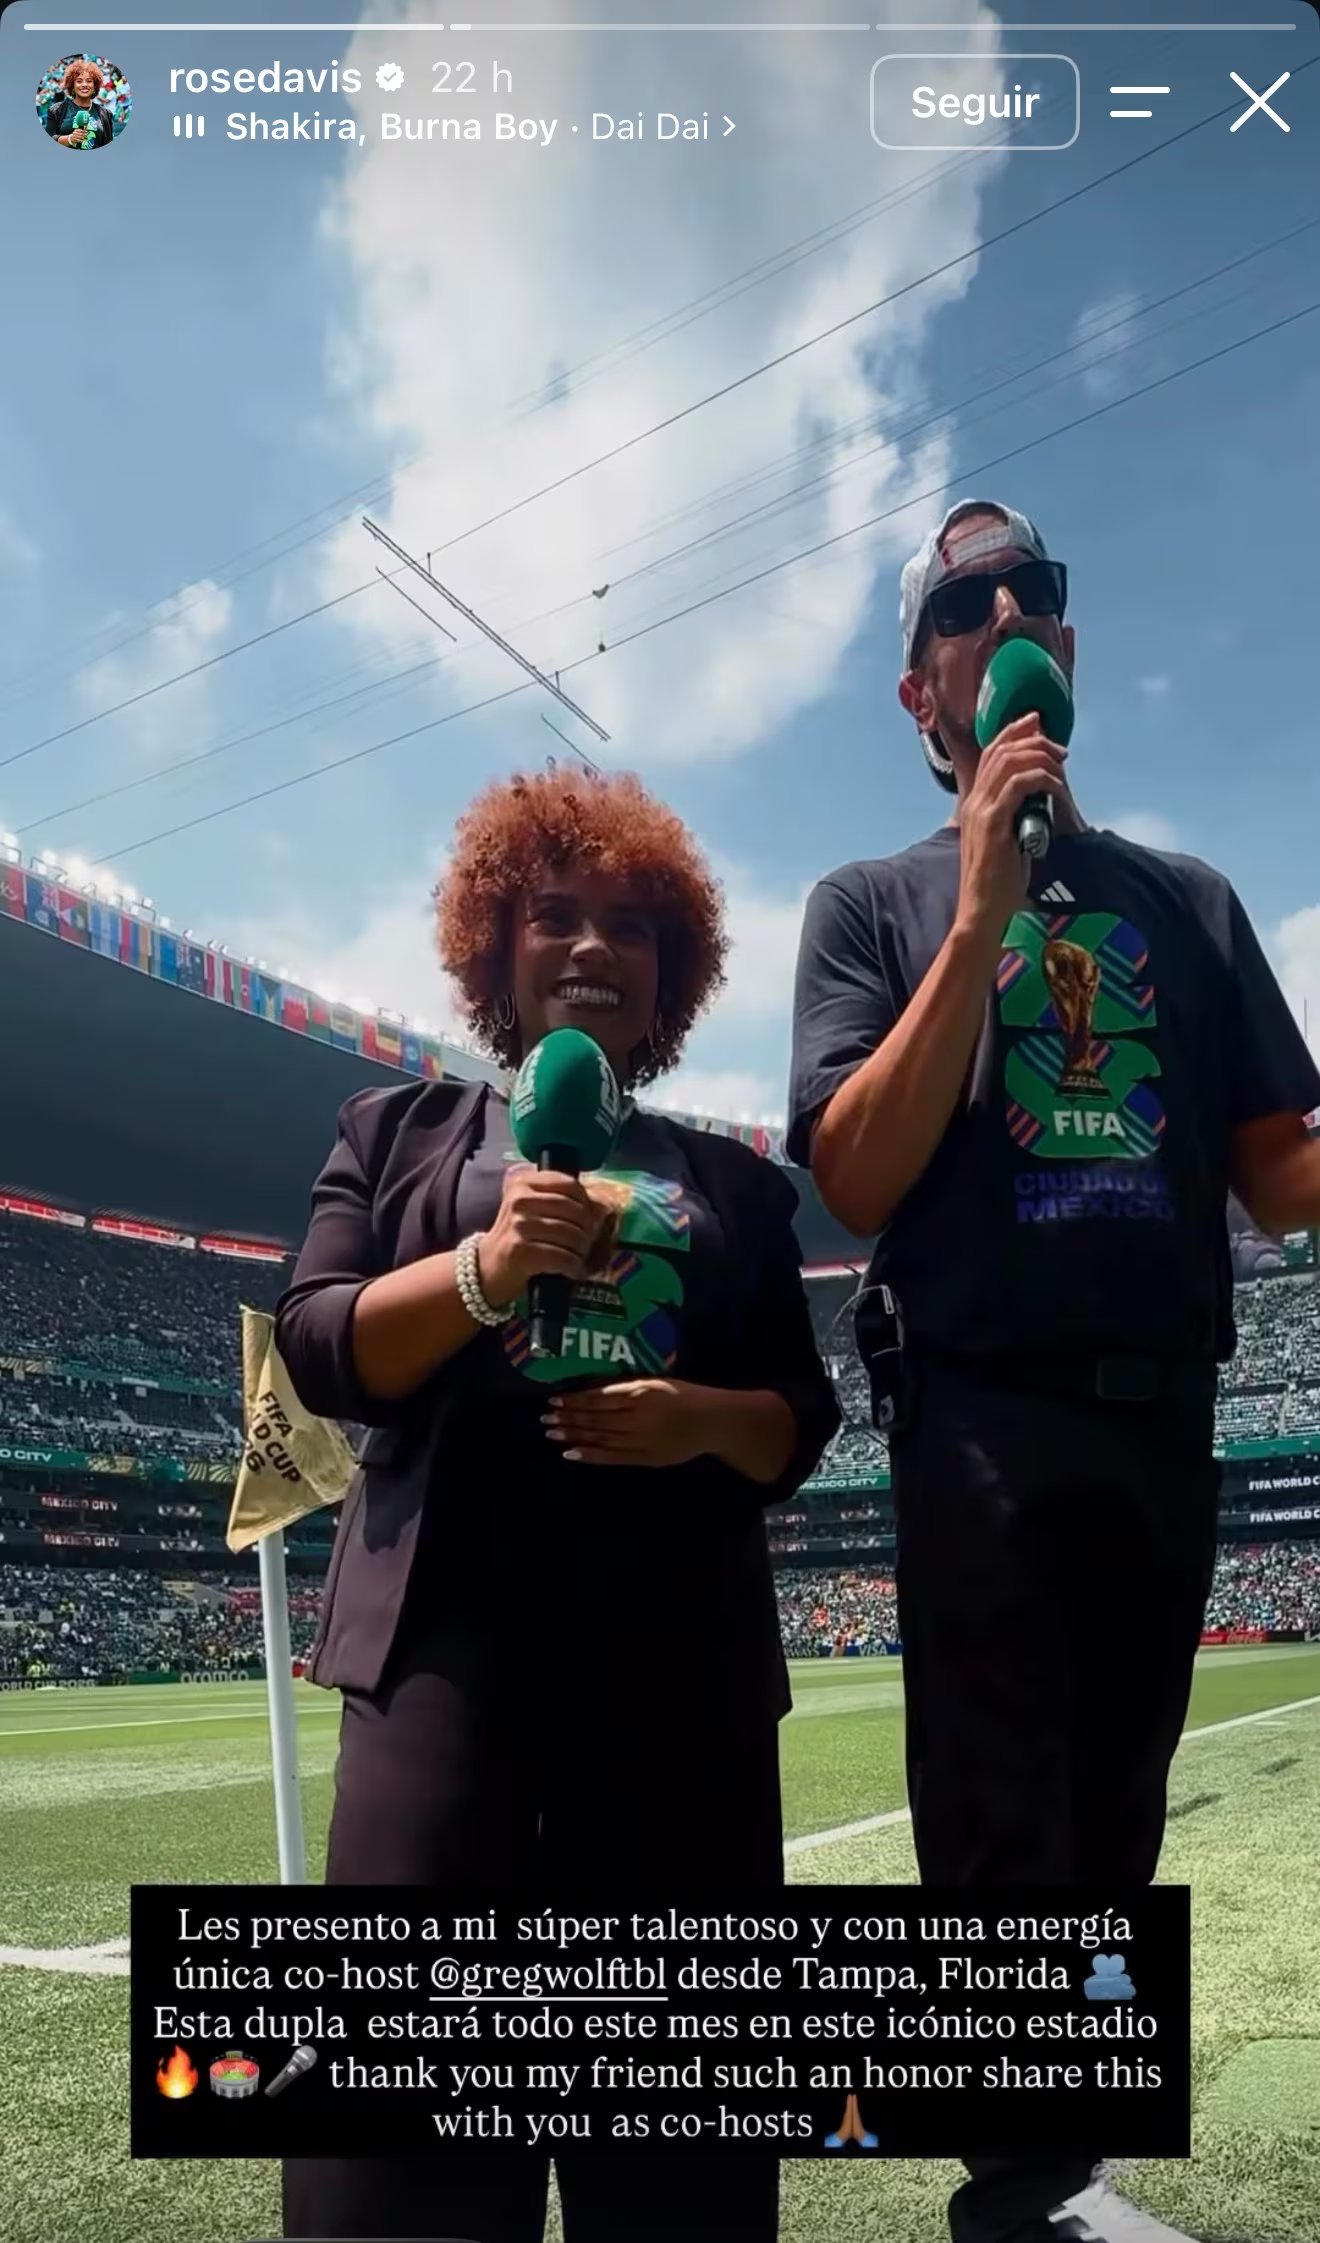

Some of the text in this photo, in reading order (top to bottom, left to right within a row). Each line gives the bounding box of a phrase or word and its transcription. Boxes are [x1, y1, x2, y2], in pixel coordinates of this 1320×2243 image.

[1053, 1110, 1126, 1137] FIFA
[562, 1326, 635, 1366] FIFA
[259, 1390, 293, 1438] FIFA
[14, 1450, 52, 1462] CITY
[265, 1441, 302, 1483] CUP
[848, 1477, 878, 1488] CITY
[1249, 1480, 1272, 1491] FIFA
[1273, 1476, 1311, 1488] WORLD
[1250, 1512, 1272, 1523] FIFA
[1274, 1510, 1312, 1522] WORLD
[858, 1645, 889, 1656] VISA
[0, 1681, 33, 1691] ORLD
